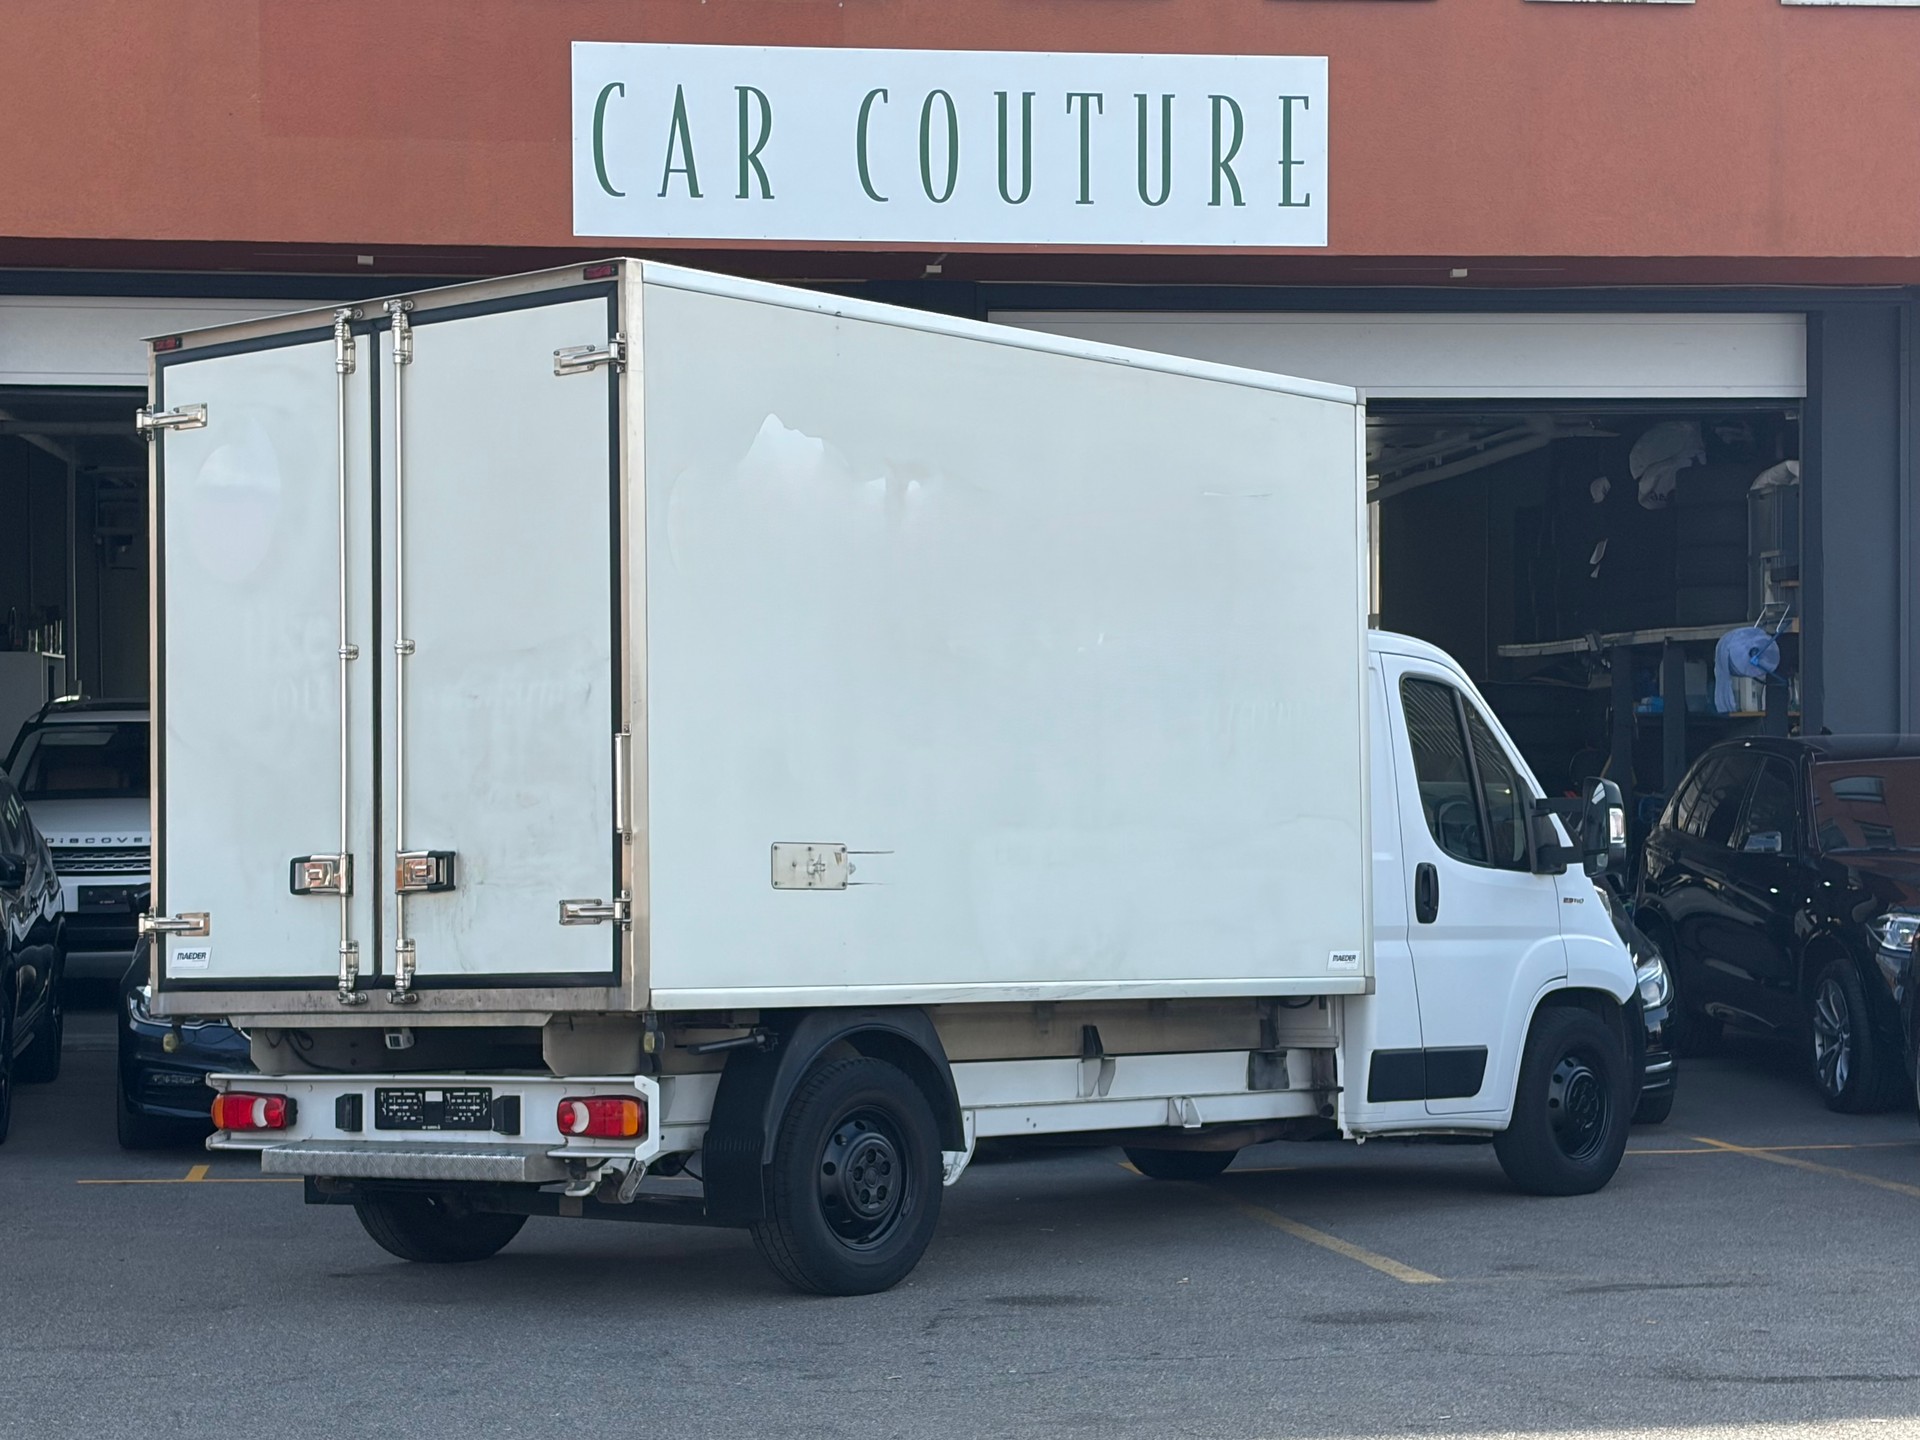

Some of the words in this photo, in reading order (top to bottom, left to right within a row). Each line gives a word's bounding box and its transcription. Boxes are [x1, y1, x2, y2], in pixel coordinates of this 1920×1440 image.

[591, 81, 776, 200] CAR
[855, 87, 1312, 209] COUTURE
[177, 952, 206, 960] MAEDER
[1332, 954, 1356, 962] MAEDER
